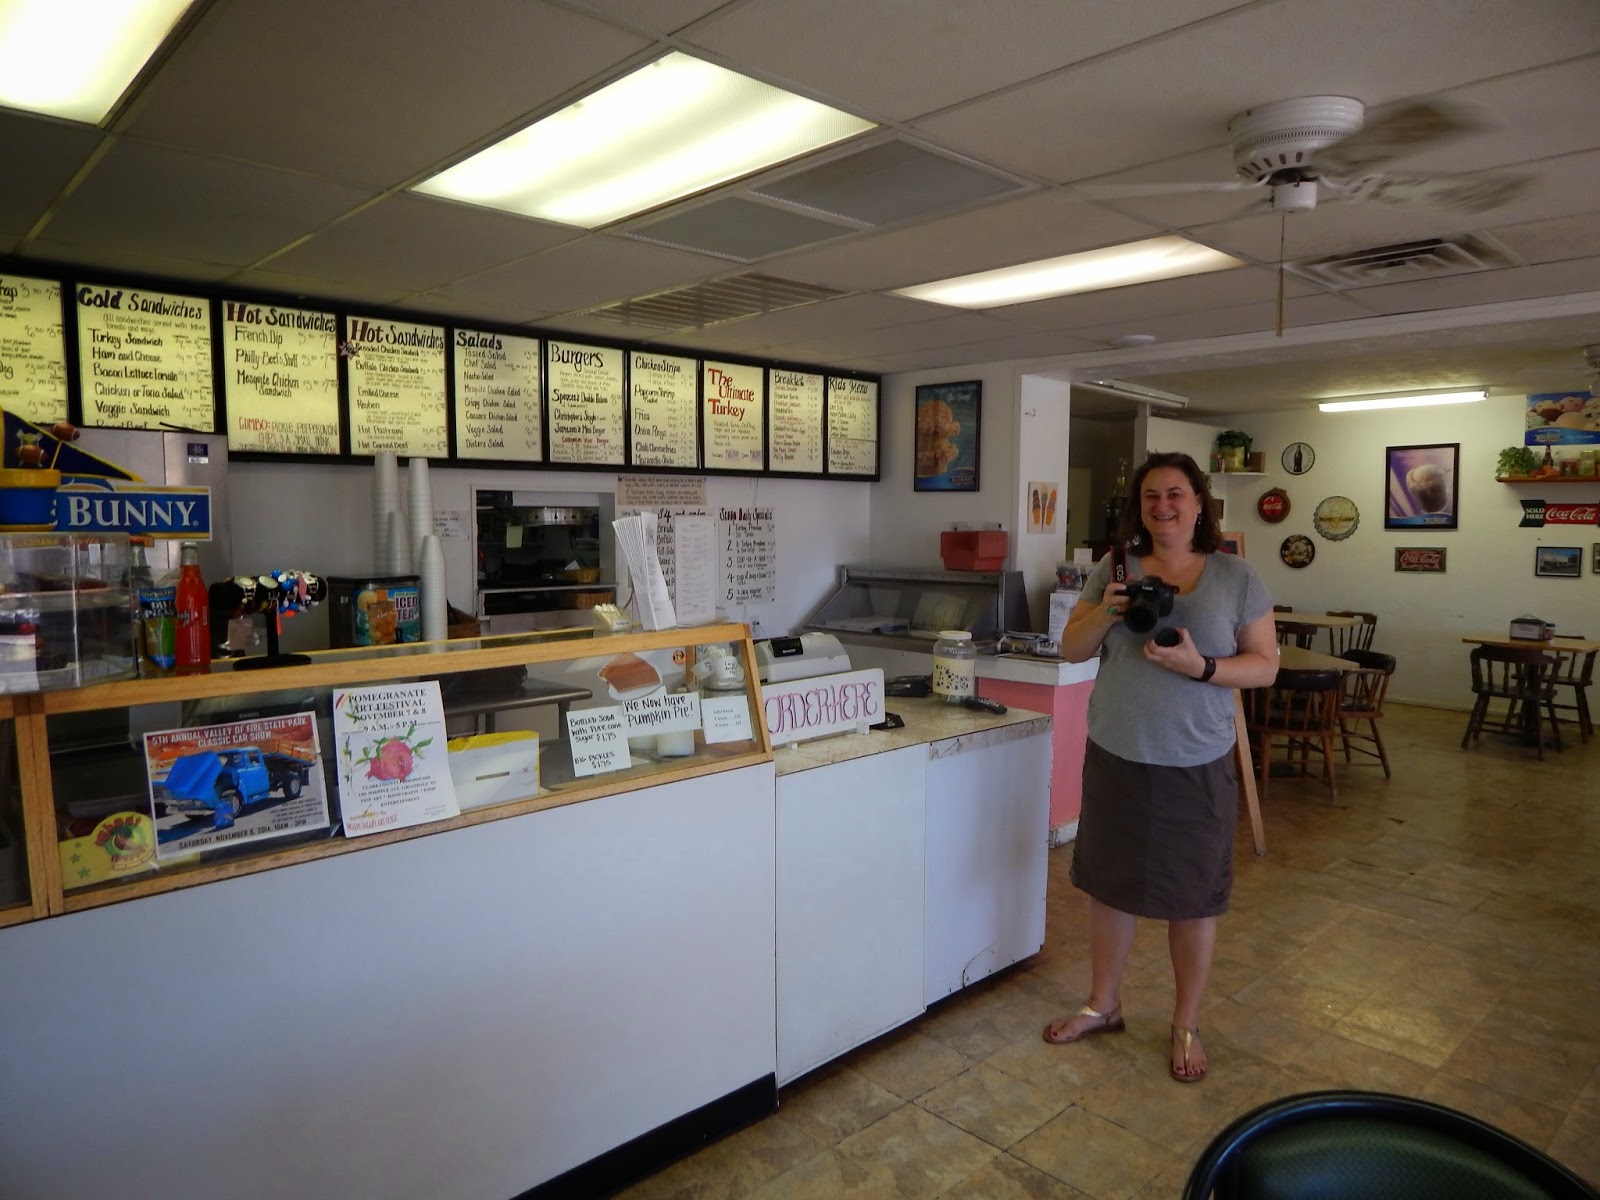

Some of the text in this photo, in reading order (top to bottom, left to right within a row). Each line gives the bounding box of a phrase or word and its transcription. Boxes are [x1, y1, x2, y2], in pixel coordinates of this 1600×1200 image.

[79, 287, 203, 319] Cold Sandwiches
[226, 303, 336, 332] Hot Sandwiches
[87, 327, 122, 349] Turkey
[125, 332, 163, 347] Sandwich
[234, 325, 268, 344] French
[270, 330, 283, 350] Dip
[350, 319, 384, 343] Hot
[386, 325, 444, 350] Sandwiches
[456, 331, 503, 351] Salads
[92, 346, 116, 360] Ham
[118, 351, 134, 361] and
[135, 351, 163, 363] Cheese
[235, 348, 260, 369] Philly
[463, 347, 486, 358] Tossed
[551, 344, 604, 373] Burgers
[93, 362, 123, 379] Bacon
[124, 366, 153, 379] Lettuce
[463, 358, 479, 368] Chef
[635, 355, 660, 371] Chicken
[272, 371, 299, 388] Chicken
[708, 367, 733, 386] The
[95, 381, 130, 398] Chicken
[141, 384, 160, 398] Tuna
[161, 387, 185, 400] Salad
[259, 385, 292, 398] Sandwich
[718, 385, 755, 402] Ultimate
[829, 377, 868, 394] Kids Menu
[95, 400, 126, 419] Veggie
[130, 402, 170, 417] Sandwich
[357, 399, 380, 410] Reuben
[707, 398, 746, 421] Turkey
[634, 407, 650, 421] Fries
[358, 425, 370, 434] Hot
[465, 424, 485, 437] Veggie
[358, 440, 370, 449] Hot
[68, 496, 197, 527] BUNNY
[727, 556, 732, 568] 3
[727, 572, 734, 583] 4
[1116, 564, 1125, 582] EOS
[395, 597, 417, 608] ICED
[727, 588, 734, 600] 5
[396, 609, 414, 621] TEA
[349, 689, 427, 703] POMEGRANATE
[624, 694, 687, 712] We Now have
[353, 698, 426, 714] ART FESTIVAL
[624, 709, 671, 727] Pumpkin
[673, 701, 693, 718] Pie!
[764, 686, 829, 735] ORDER
[831, 681, 878, 722] HERE
[171, 731, 201, 743] ANNUAL
[204, 726, 232, 738] VALLEY
[234, 724, 244, 734] OF
[246, 723, 263, 732] FIRE
[264, 719, 286, 730] STATE
[288, 717, 306, 727] PARK
[198, 730, 272, 747] CLASSIC CAR SHOW
[596, 732, 617, 742] $1.75
[574, 751, 616, 765] BIG PICKLES
[592, 760, 612, 769] $1.75
[216, 830, 248, 842] NOVEMBER
